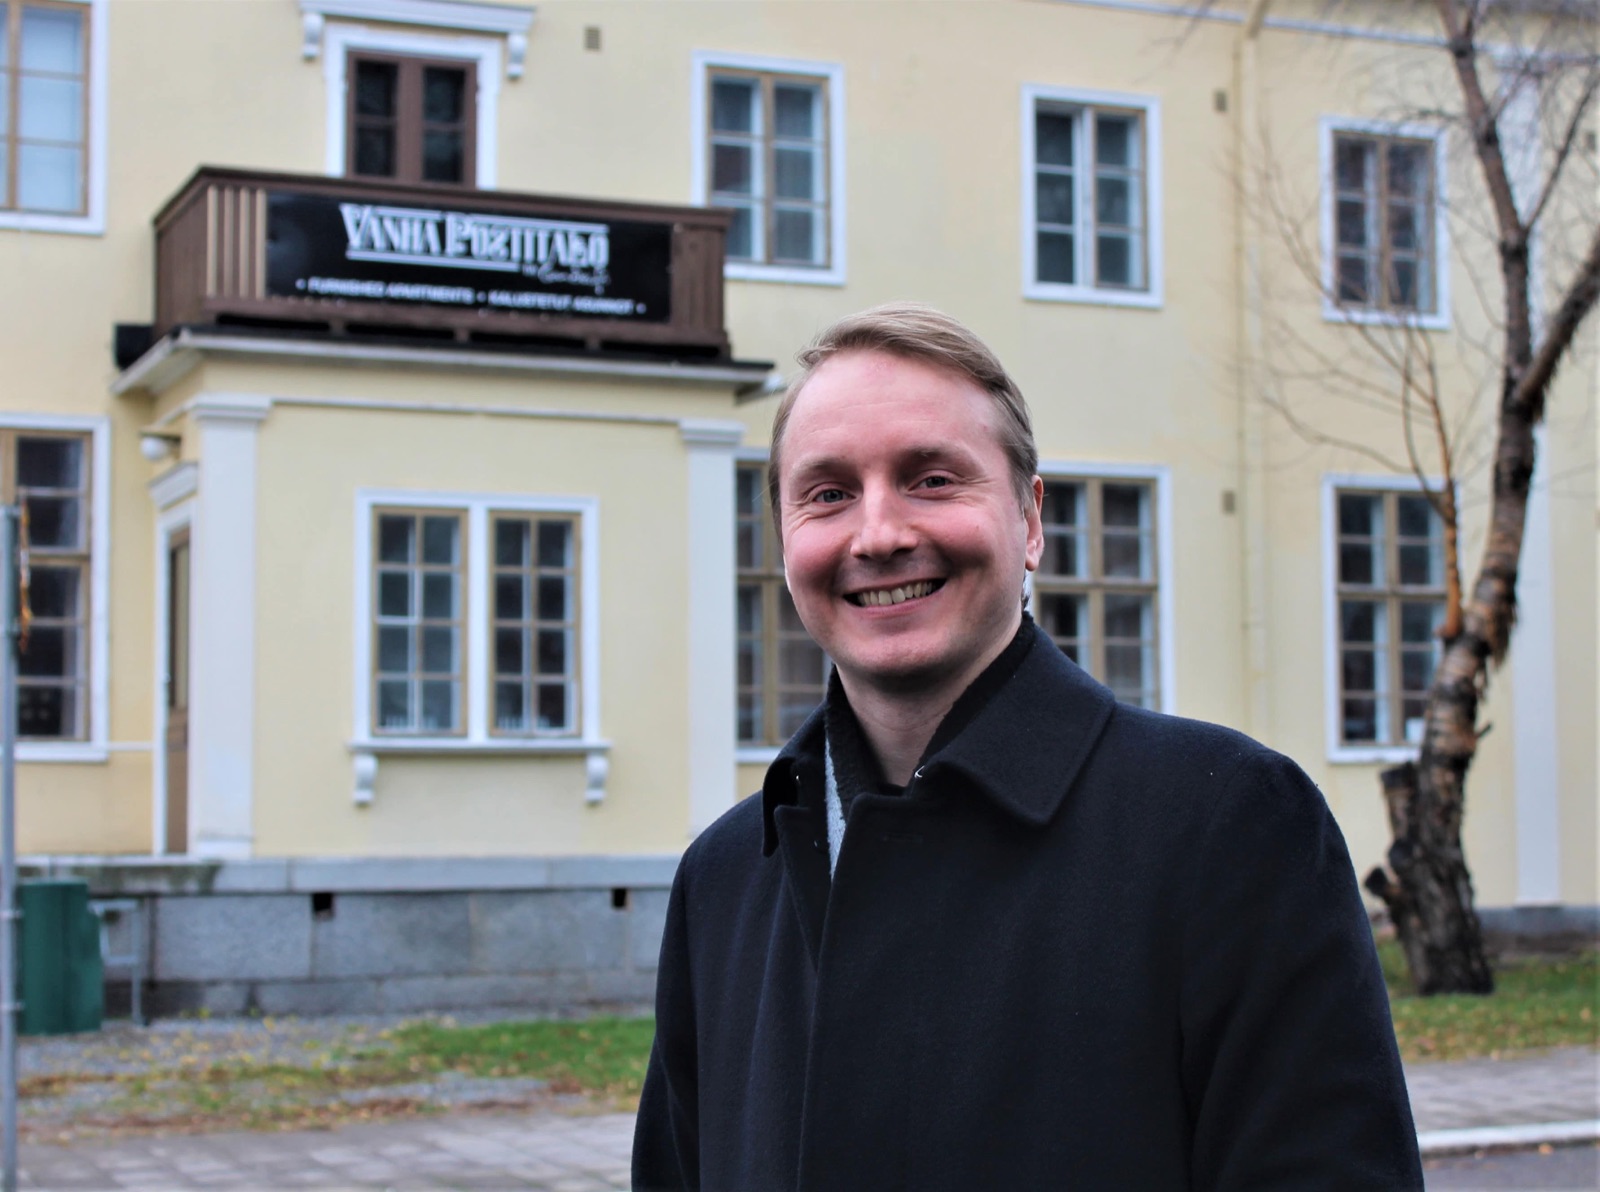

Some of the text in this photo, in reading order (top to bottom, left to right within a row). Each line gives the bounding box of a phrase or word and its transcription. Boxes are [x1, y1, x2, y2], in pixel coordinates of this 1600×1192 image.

[308, 277, 385, 298] FURNISHED
[386, 282, 475, 304] APARTMENTS
[488, 290, 572, 310] KALUSTETUT
